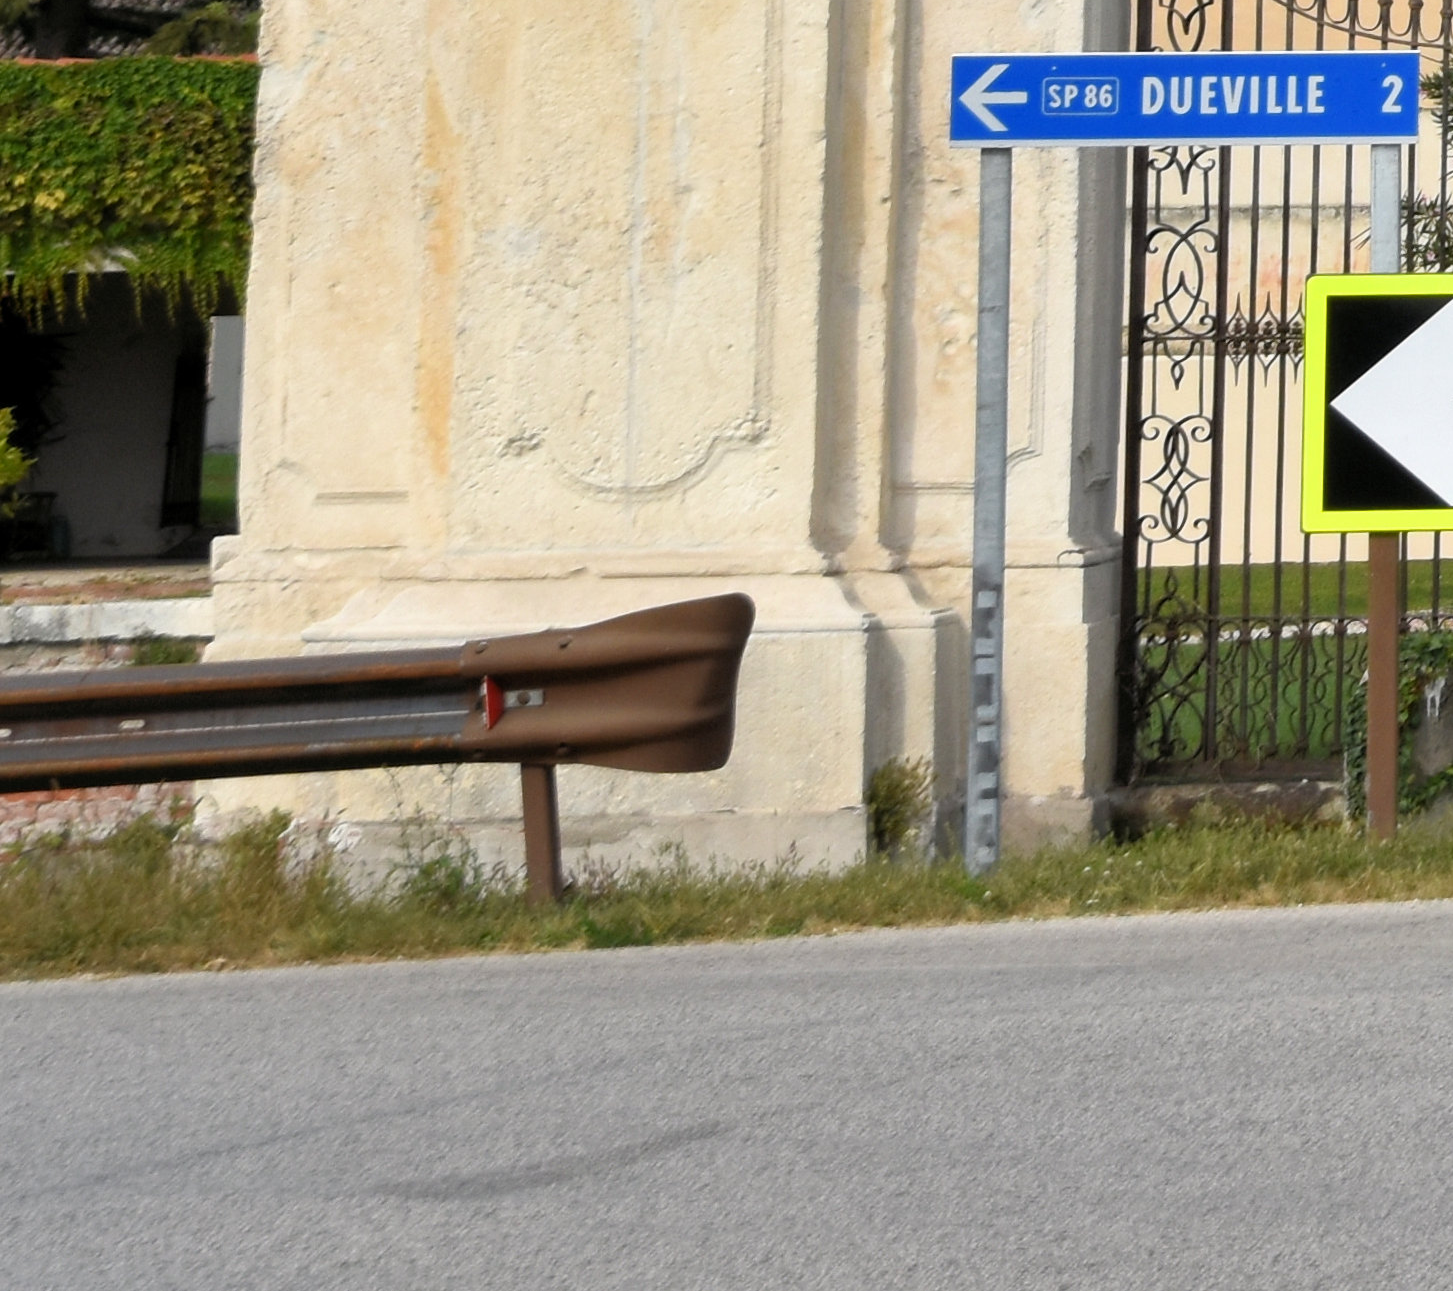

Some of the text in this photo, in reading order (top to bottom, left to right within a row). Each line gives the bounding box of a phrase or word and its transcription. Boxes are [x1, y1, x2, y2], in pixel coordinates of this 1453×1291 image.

[1048, 74, 1404, 116] SP 86 DUEVILLE 2
